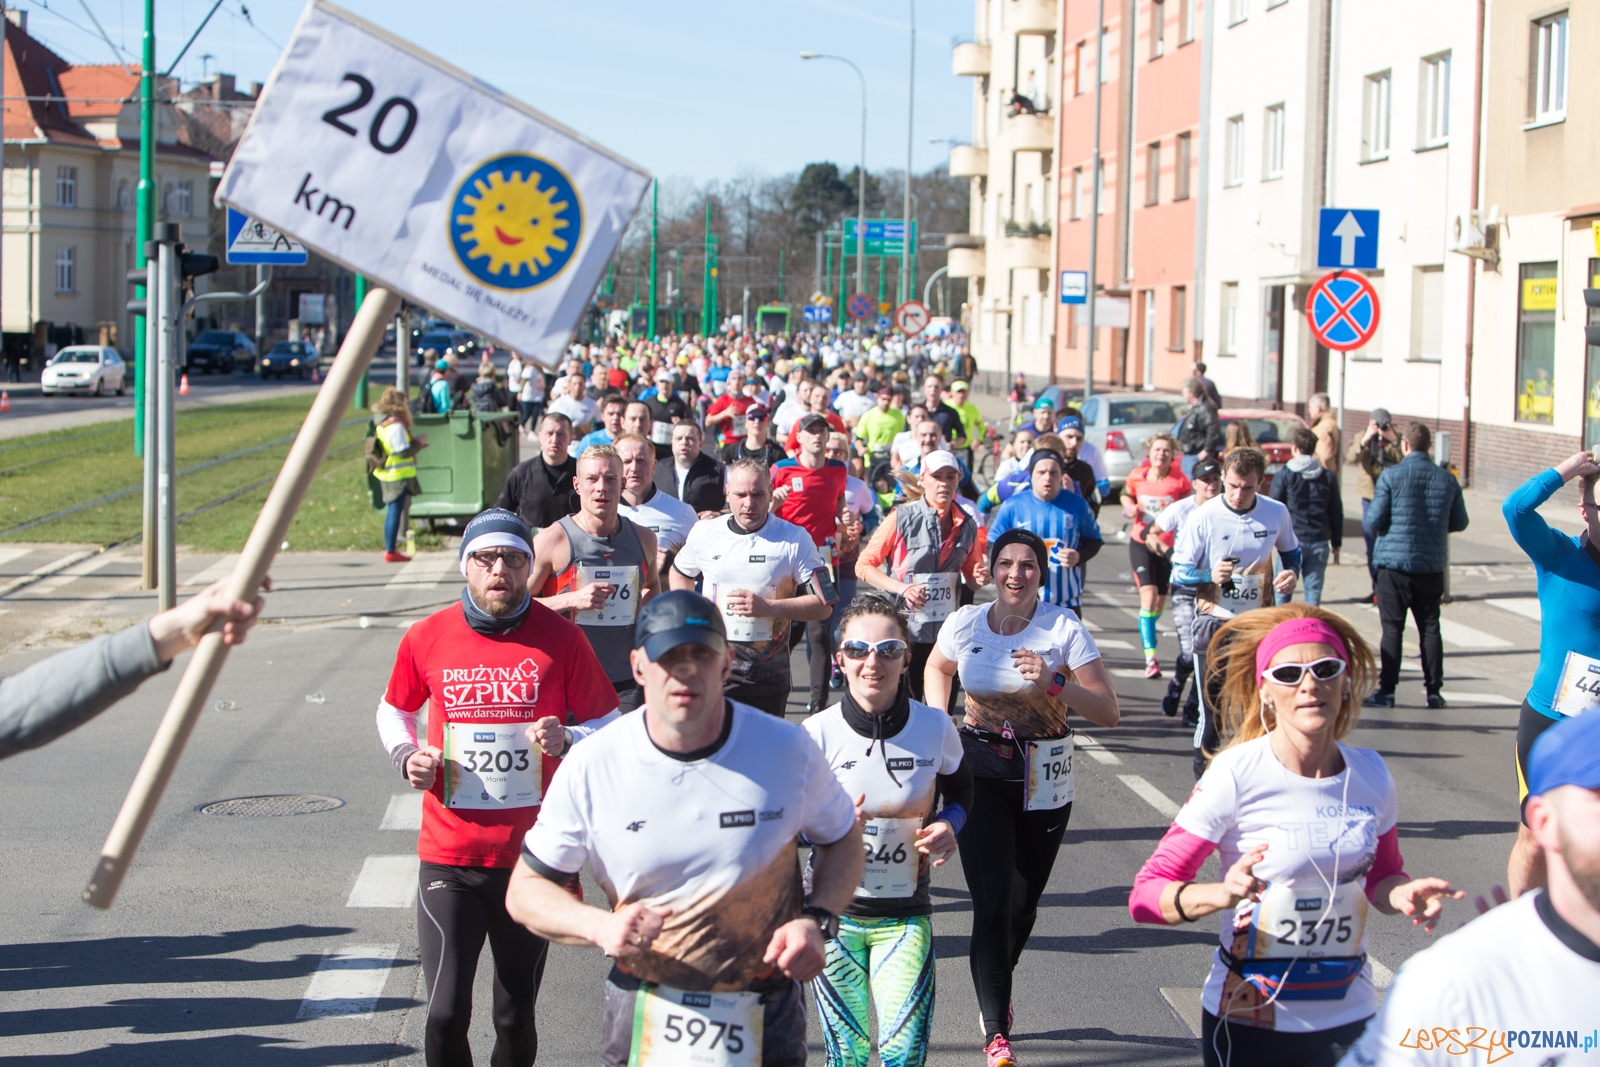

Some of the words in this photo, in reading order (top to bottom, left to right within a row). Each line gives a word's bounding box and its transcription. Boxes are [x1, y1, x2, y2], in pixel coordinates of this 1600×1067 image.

[321, 72, 418, 154] 20
[293, 172, 356, 231] km
[420, 262, 461, 291] MEDAL
[604, 584, 630, 600] 76
[923, 587, 952, 602] 5278
[442, 664, 522, 683] DRUŻYNA
[443, 681, 540, 708] SZPIKU
[1575, 676, 1600, 697] 44
[448, 708, 534, 720] www.darszpiku.pl
[463, 749, 529, 773] 3203
[841, 761, 857, 770] 4F
[1042, 755, 1073, 781] 1943
[626, 820, 646, 832] 4F
[734, 813, 753, 824] PKO
[864, 842, 907, 865] 246
[1277, 915, 1352, 946] 2375
[664, 1014, 744, 1054] 5975
